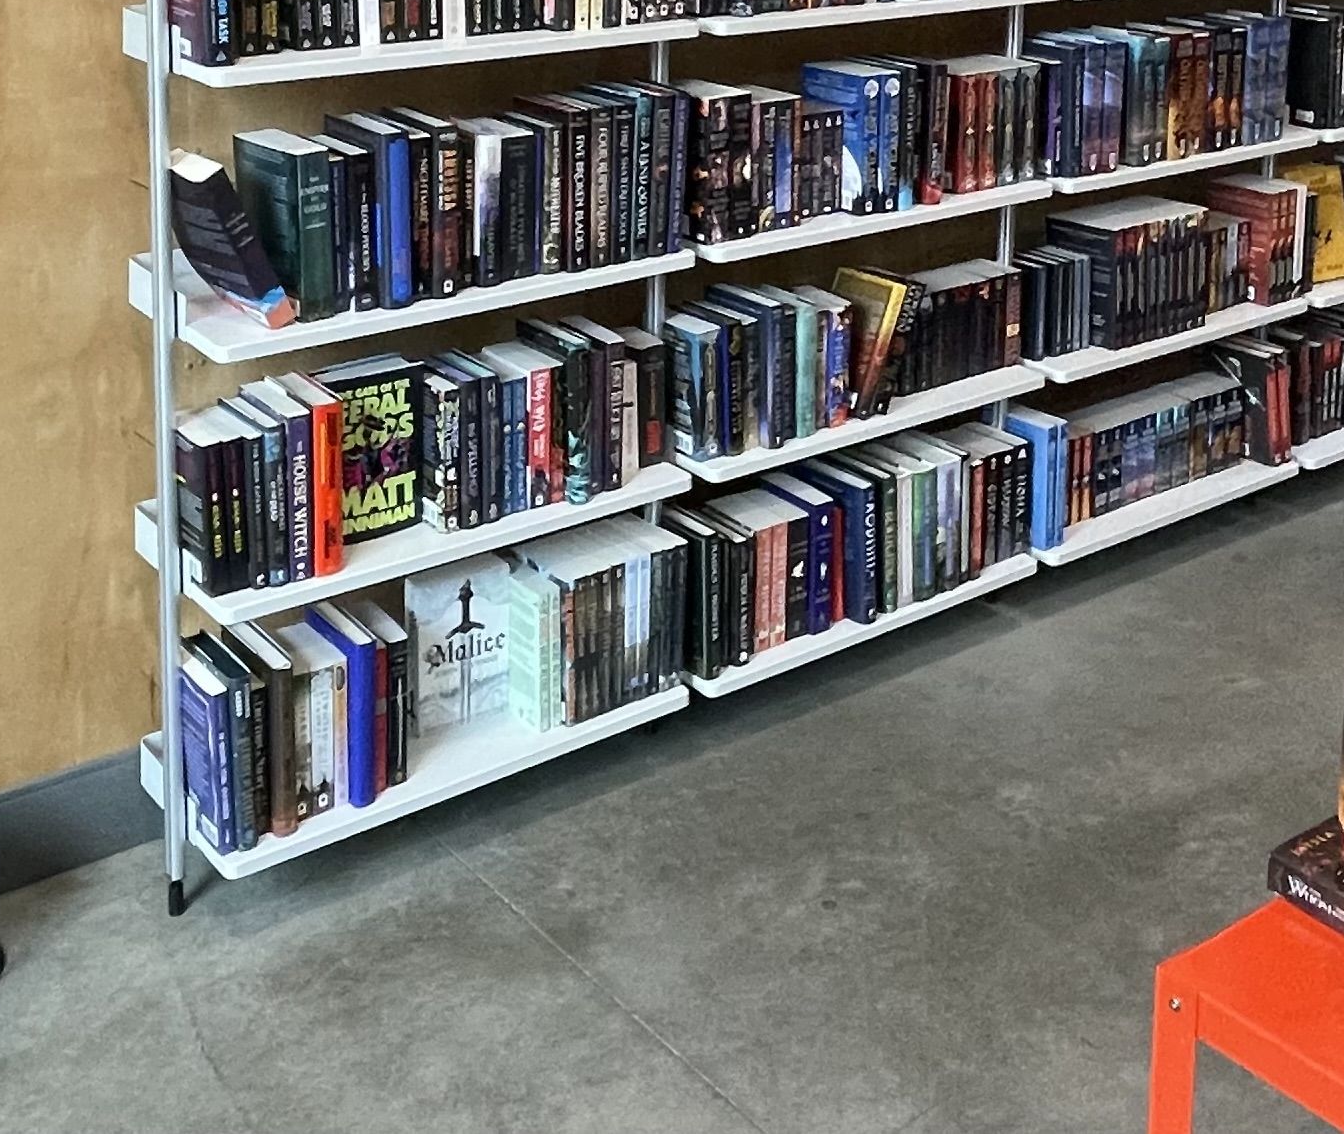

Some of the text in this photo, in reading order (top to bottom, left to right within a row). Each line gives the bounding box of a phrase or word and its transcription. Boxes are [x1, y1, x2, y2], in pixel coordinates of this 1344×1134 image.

[217, 17, 230, 45] TASK
[639, 141, 651, 151] A
[575, 134, 586, 252] FIVE BROKEN BLADES
[343, 388, 411, 423] FERAL
[292, 454, 308, 559] HOUSE WITCH
[342, 470, 417, 516] MATT
[343, 502, 416, 535] INNIMAN
[425, 630, 506, 674] Malice
